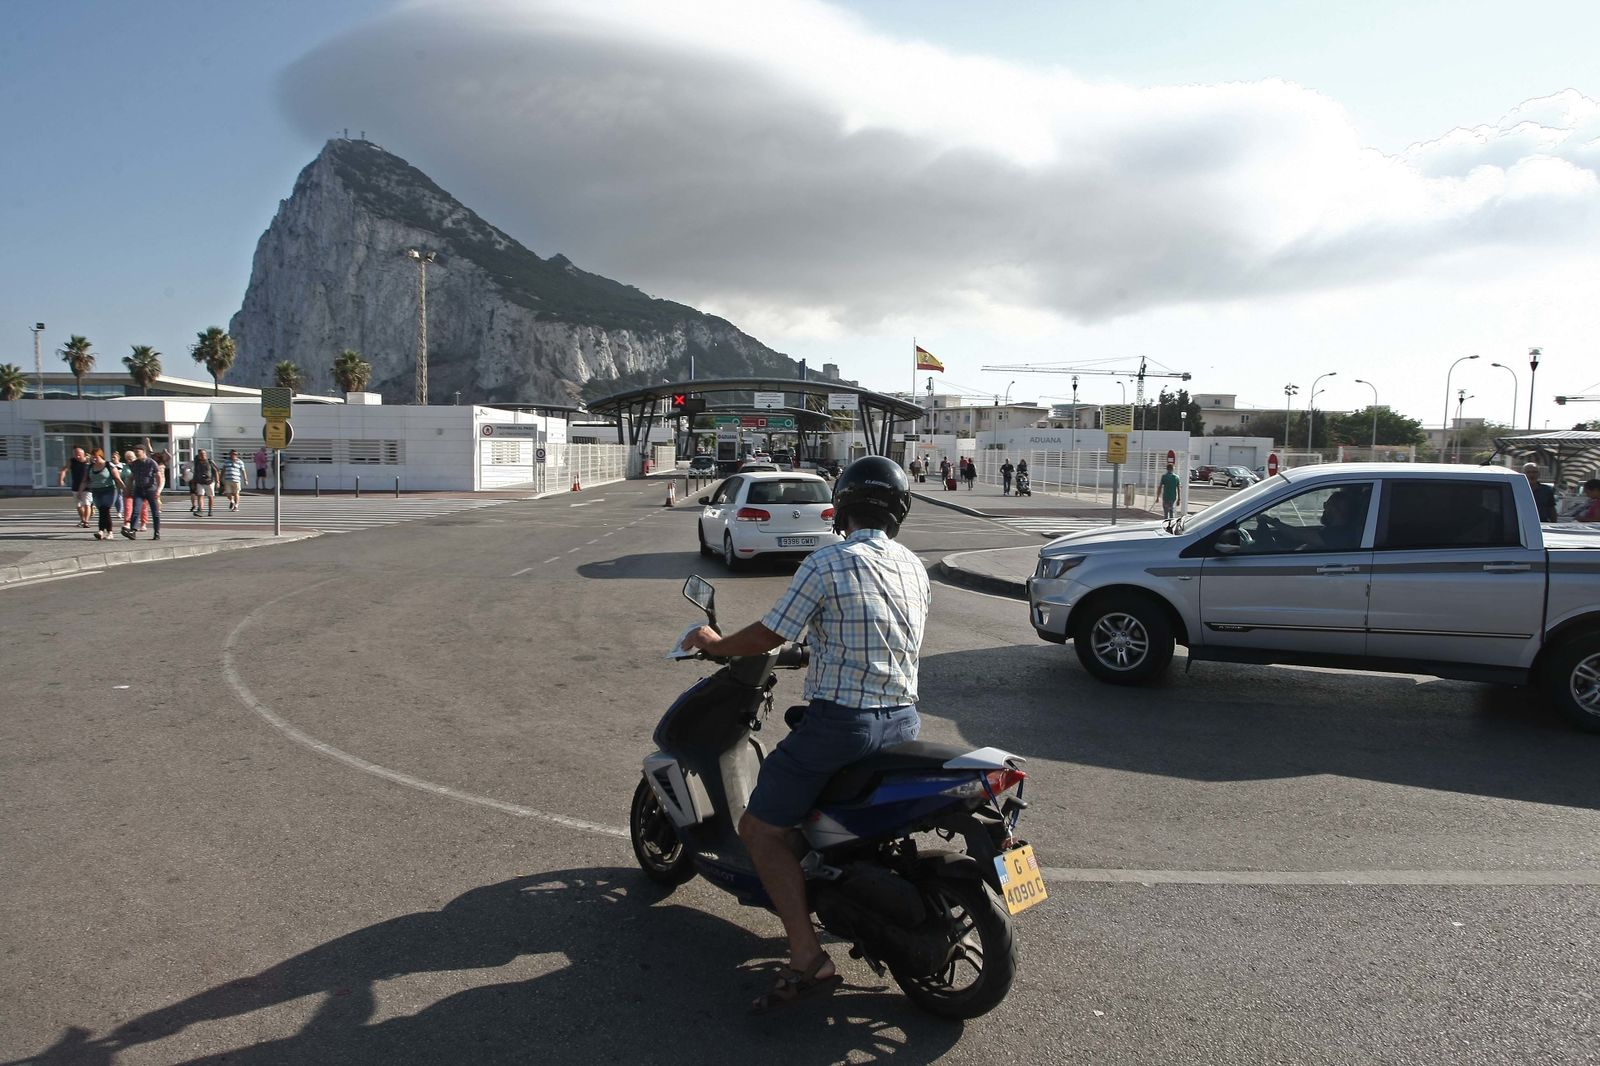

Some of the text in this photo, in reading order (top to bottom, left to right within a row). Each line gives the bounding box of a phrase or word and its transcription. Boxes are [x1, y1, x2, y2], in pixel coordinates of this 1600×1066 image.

[1030, 436, 1062, 444] ADUANA
[1013, 858, 1023, 875] G
[1007, 876, 1044, 906] 4090 C
